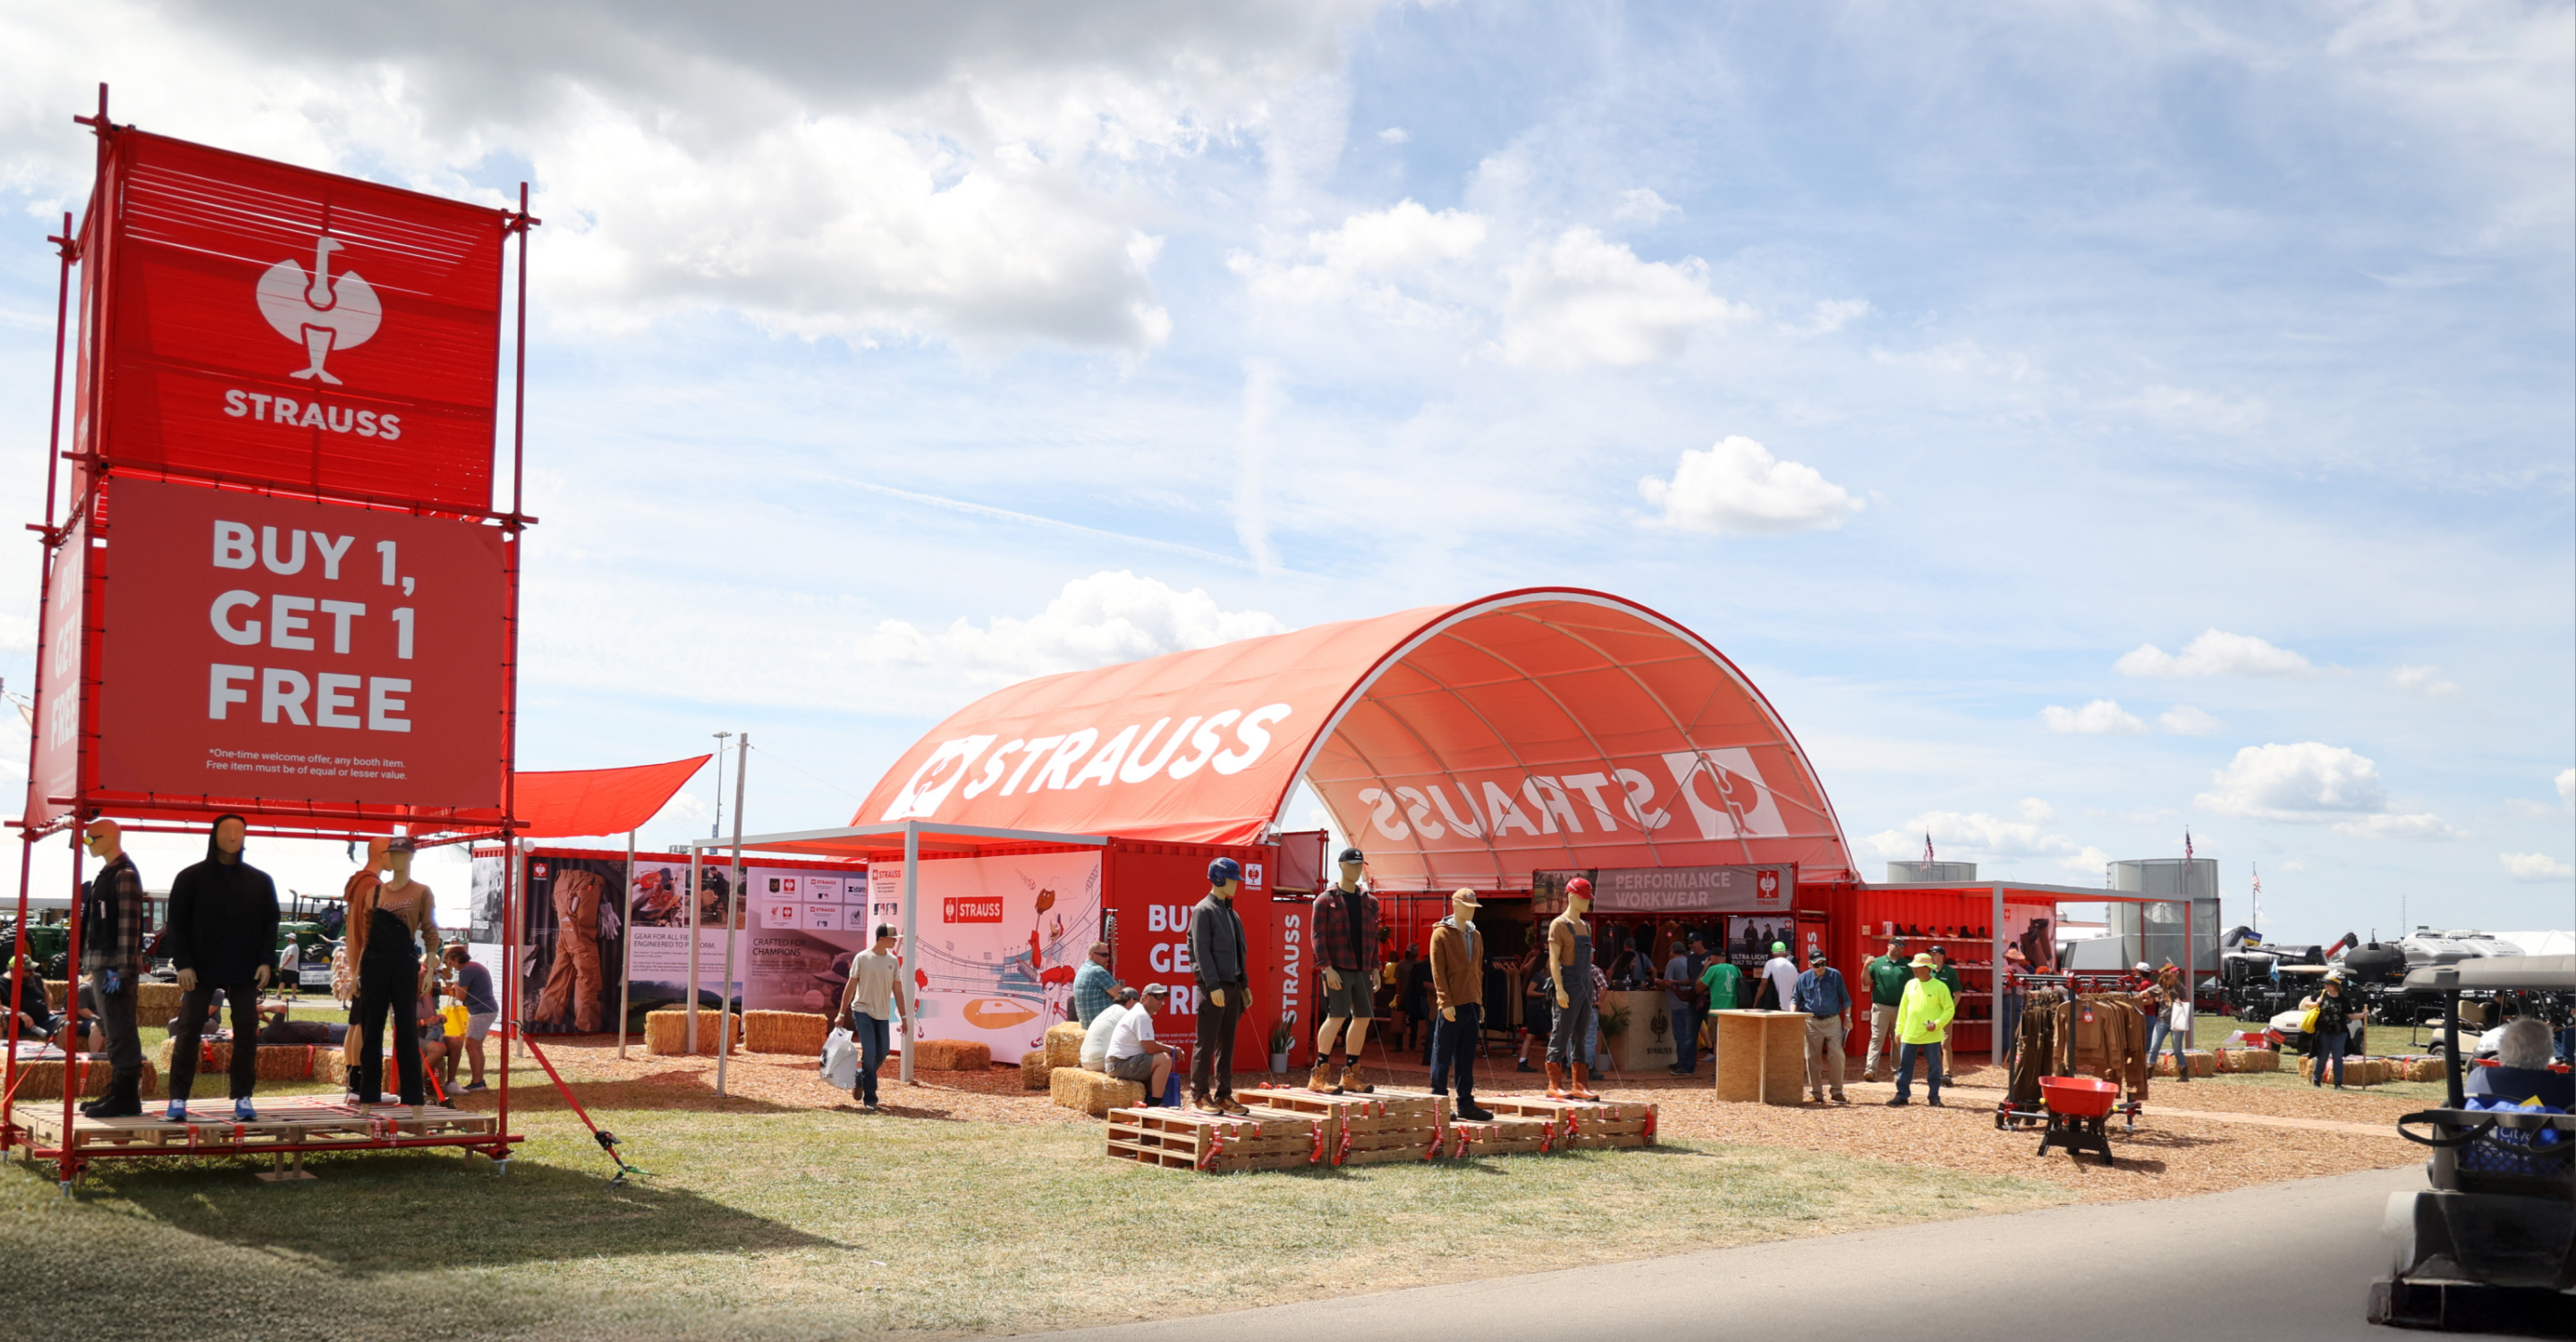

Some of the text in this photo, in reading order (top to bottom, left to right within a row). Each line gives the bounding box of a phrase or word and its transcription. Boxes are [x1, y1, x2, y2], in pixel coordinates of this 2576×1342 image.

[223, 389, 402, 441] STRAUSS
[213, 520, 416, 597] BUY 1,
[59, 548, 79, 610] BUY
[209, 590, 415, 660] GET 1
[55, 612, 76, 679] GET
[208, 663, 411, 733] FREE
[50, 681, 78, 752] FREE
[261, 752, 306, 763] welcome
[308, 754, 333, 765] offer,
[335, 757, 352, 767] any
[353, 756, 381, 767] booth
[383, 759, 406, 769] item.
[963, 703, 1292, 799] STRAUSS
[206, 760, 408, 780] Free item must be of equal or lesser value.
[879, 870, 901, 879] STRAUSS
[1615, 871, 1731, 889] PERFORMANCE
[1615, 891, 1708, 907] WORKWEAR
[473, 910, 481, 920] THE
[960, 902, 1001, 917] STRAUSS
[472, 921, 489, 930] STRAUSS
[752, 947, 801, 956] CHAMPIONS
[753, 938, 807, 947] CRAFTED FOR
[1282, 913, 1300, 1023] STRAUSS
[1647, 1047, 1673, 1055] STRAUSS
